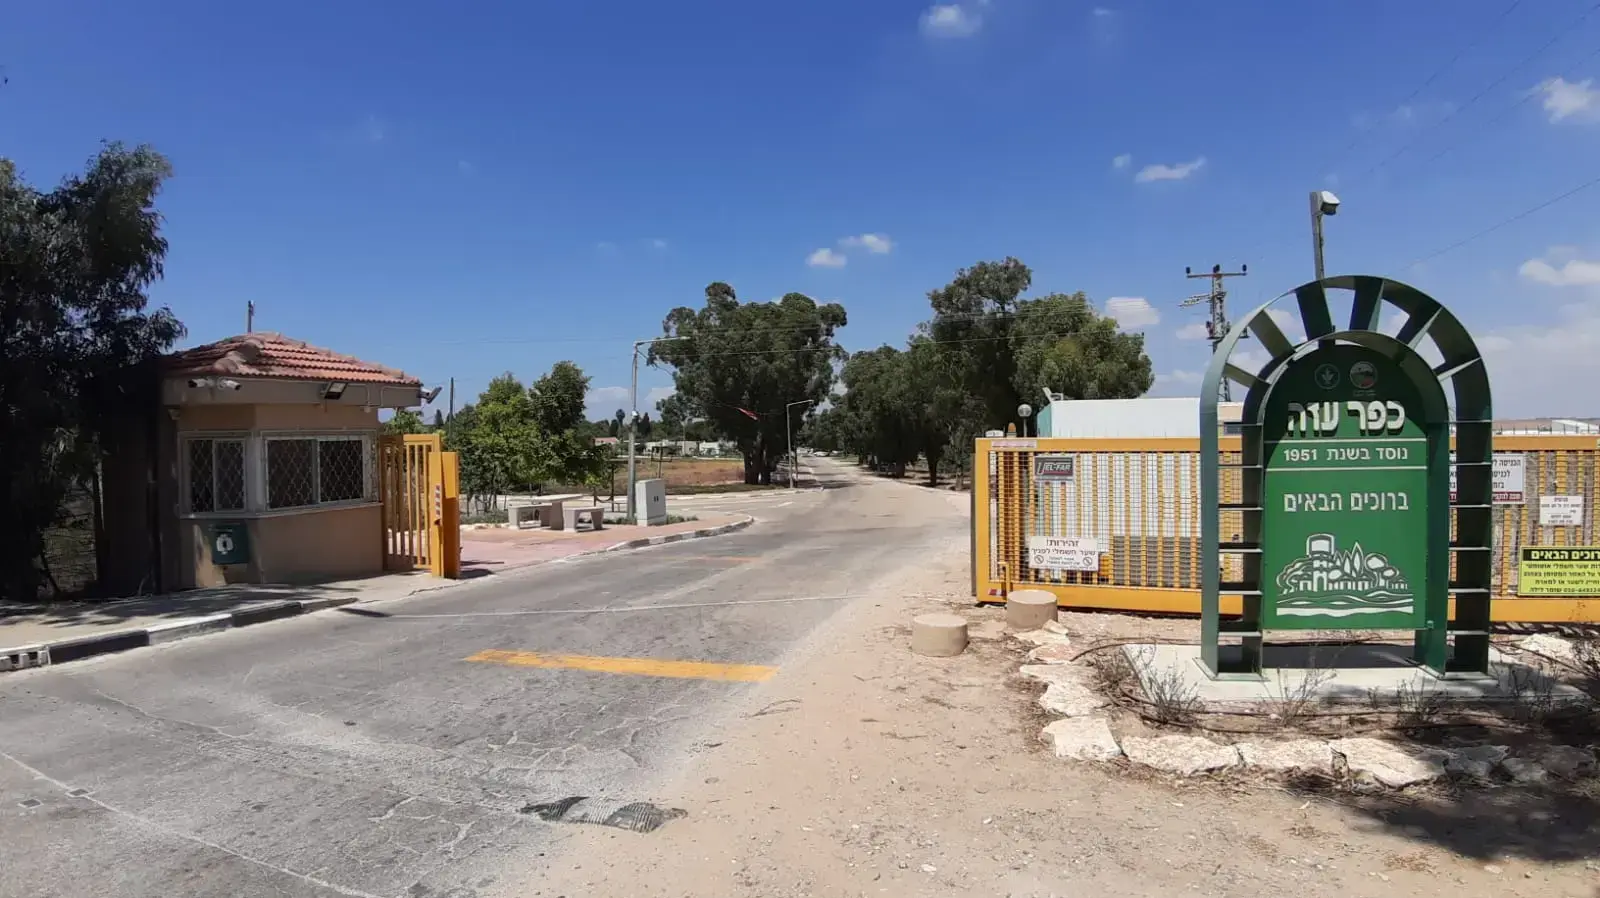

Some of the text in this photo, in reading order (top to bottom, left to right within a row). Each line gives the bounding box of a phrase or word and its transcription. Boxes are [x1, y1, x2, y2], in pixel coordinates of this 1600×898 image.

[1287, 400, 1406, 433] כפר עזה
[1283, 447, 1408, 462] נוסד בשנת 1951
[1283, 492, 1409, 512] ברוכים הבאים
[1046, 537, 1079, 547] זהירות!
[1531, 550, 1600, 560] רוכים הבאים
